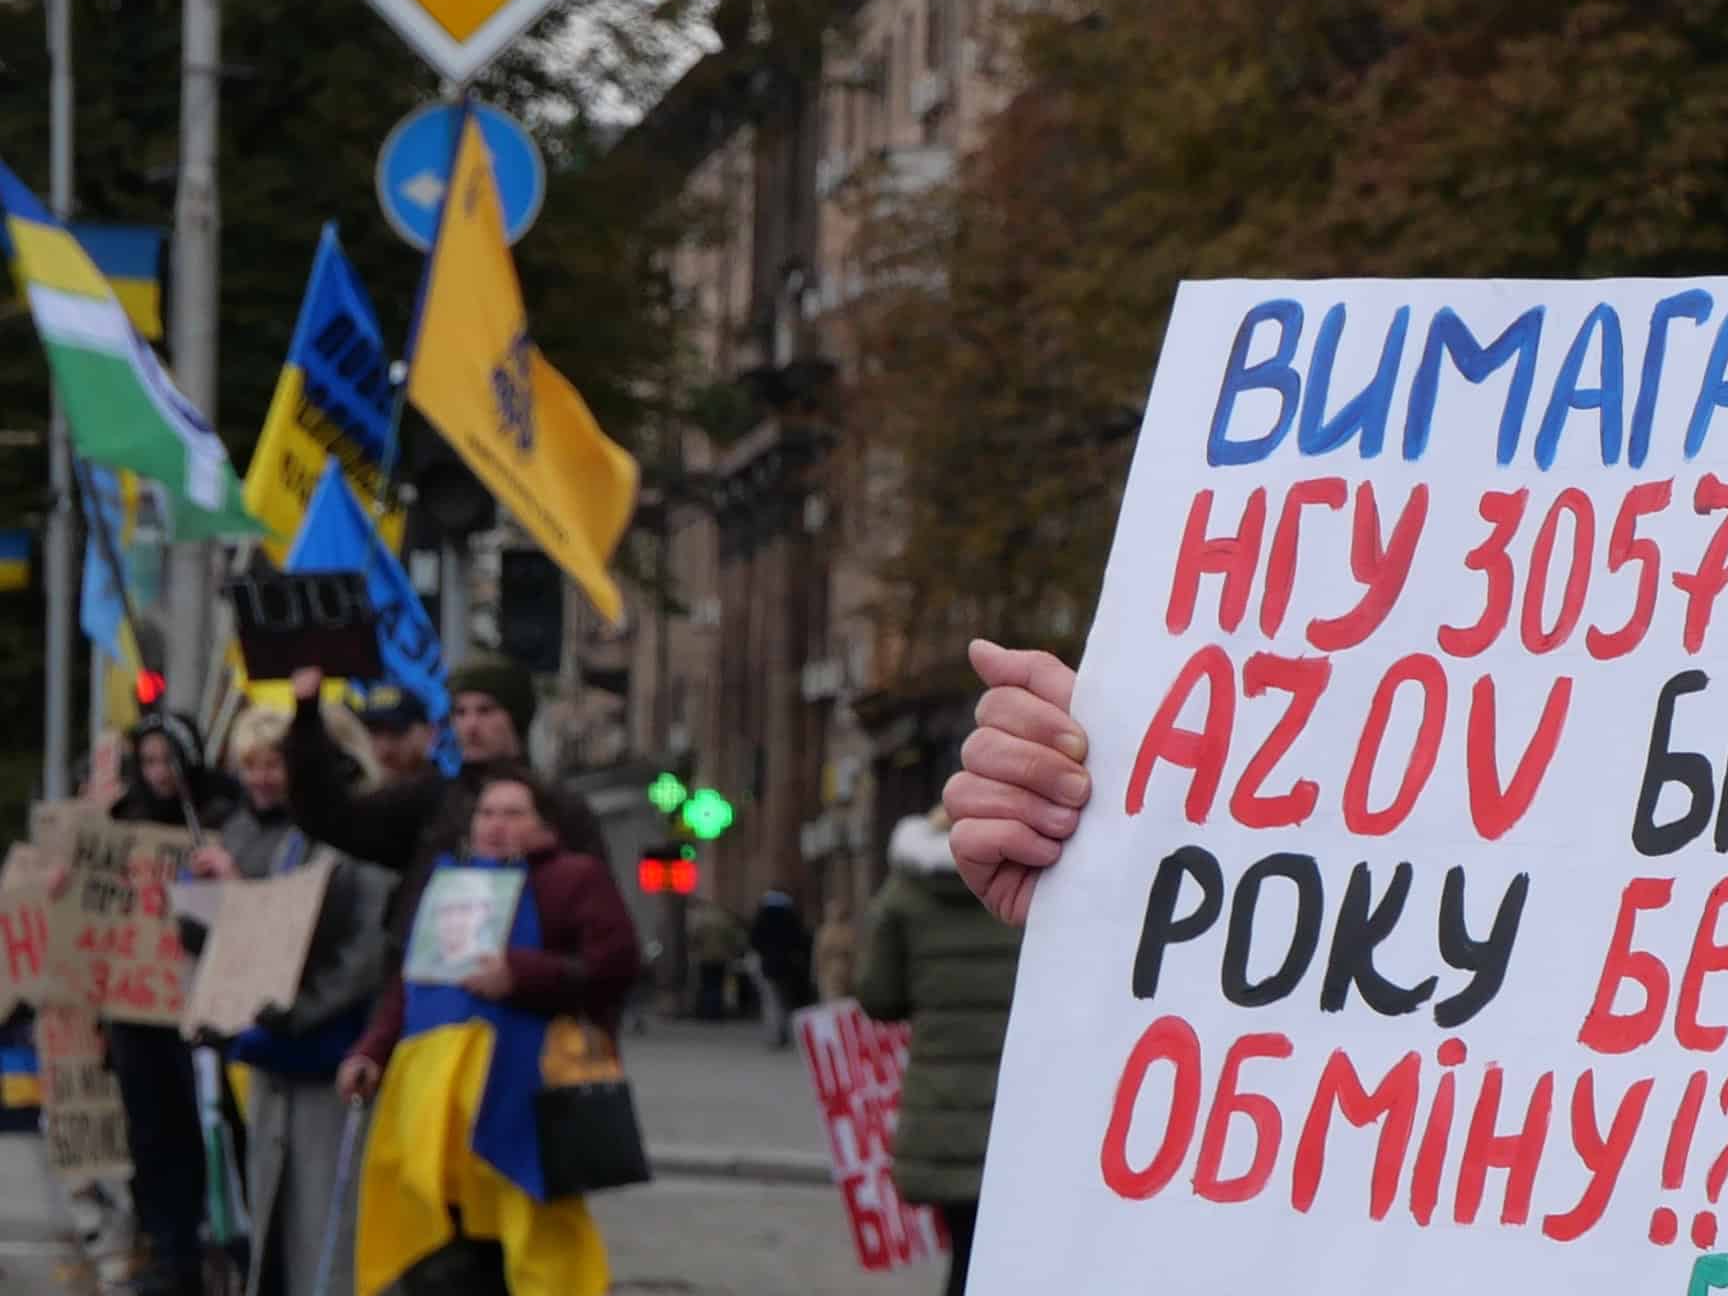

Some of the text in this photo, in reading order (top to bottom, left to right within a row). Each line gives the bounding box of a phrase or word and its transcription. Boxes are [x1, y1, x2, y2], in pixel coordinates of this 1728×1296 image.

[1165, 477, 1428, 656] НГУ
[1124, 642, 1574, 842] AZOV
[1132, 846, 1531, 1030] РОКУ
